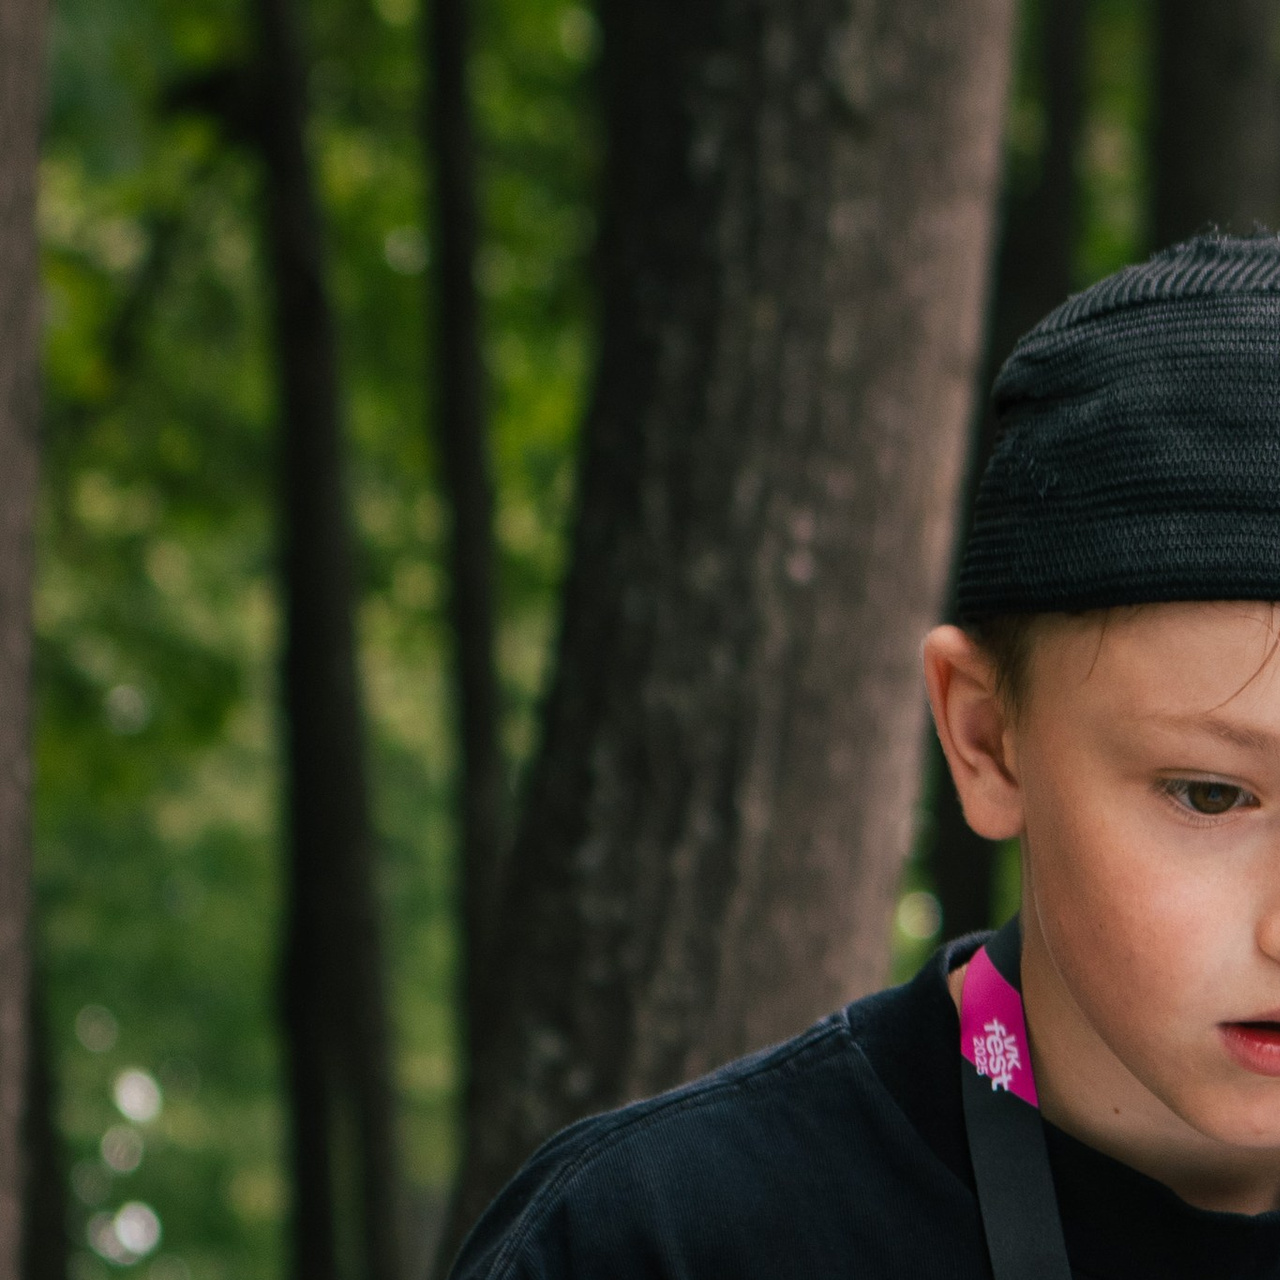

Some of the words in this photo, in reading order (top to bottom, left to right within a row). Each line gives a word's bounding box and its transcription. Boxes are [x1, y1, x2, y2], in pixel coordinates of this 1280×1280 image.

[972, 1036, 989, 1076] 2025
[983, 1017, 1013, 1092] fest
[1003, 1034, 1022, 1071] VK
